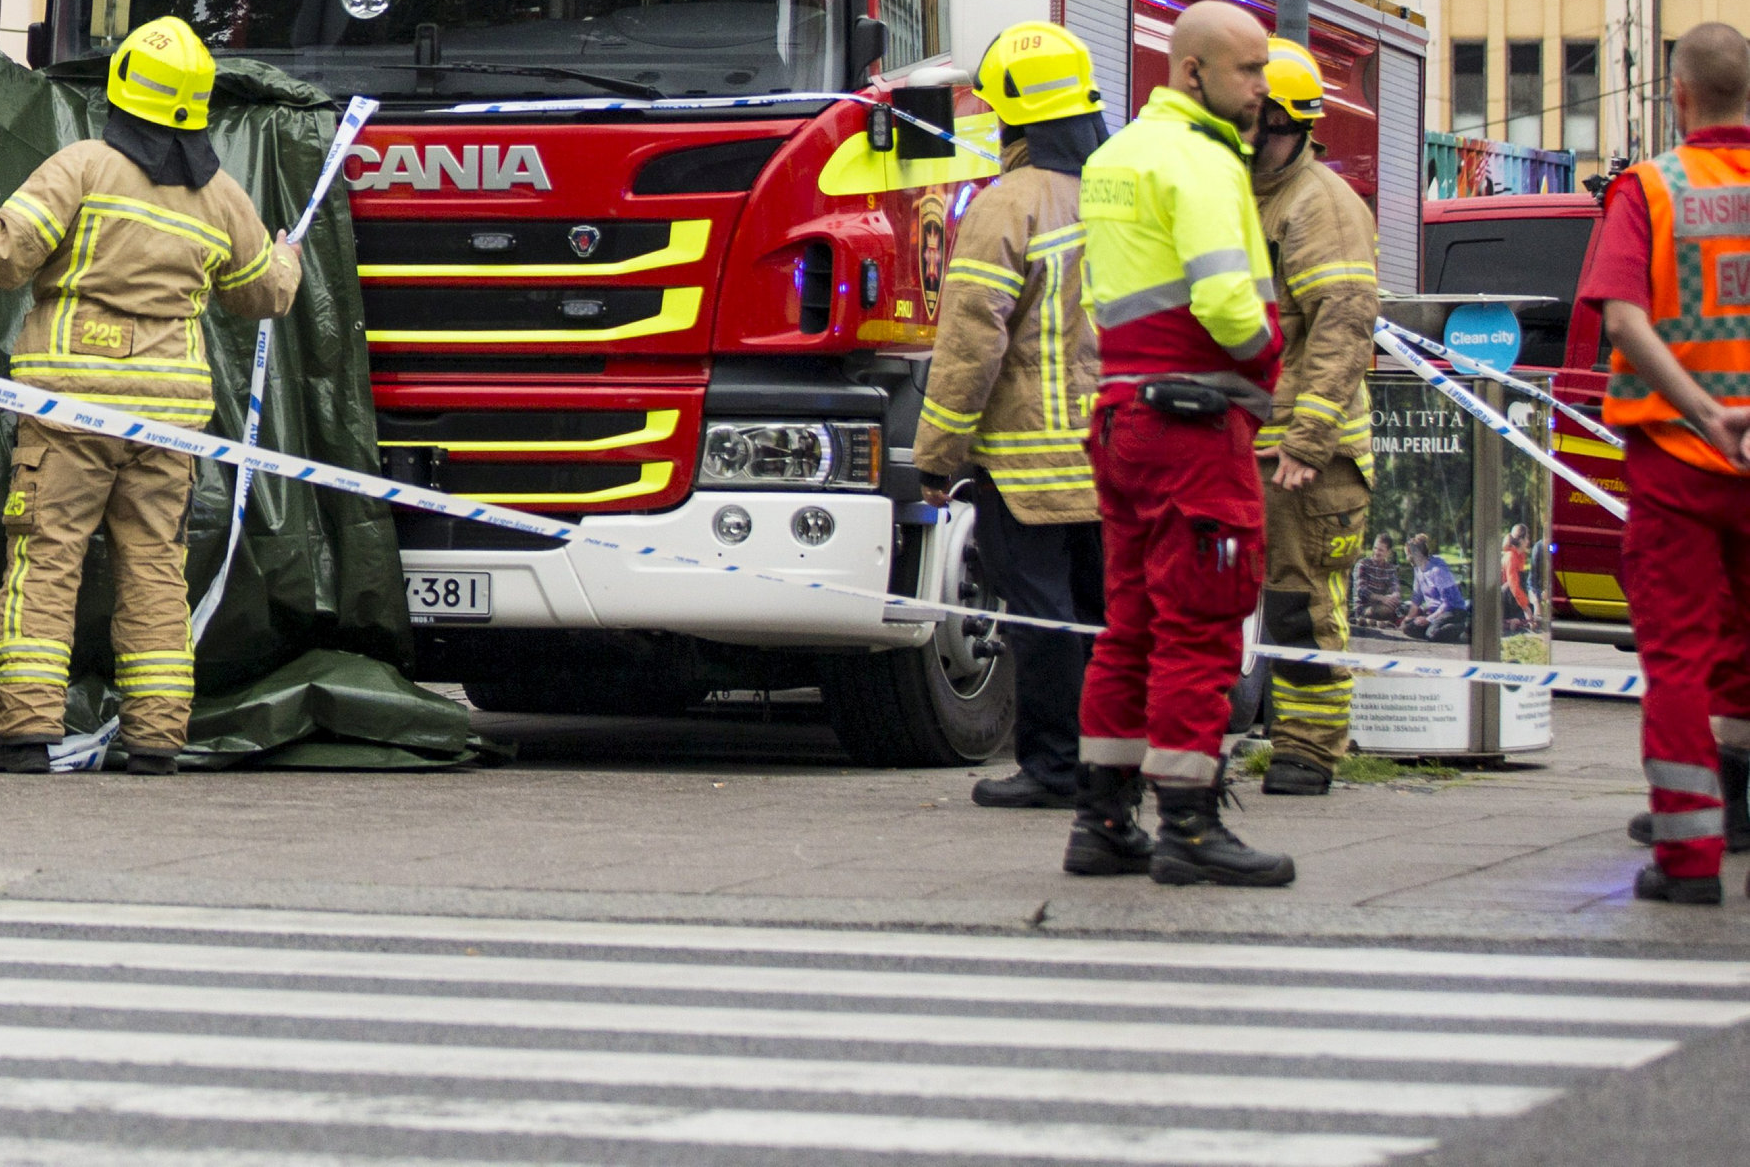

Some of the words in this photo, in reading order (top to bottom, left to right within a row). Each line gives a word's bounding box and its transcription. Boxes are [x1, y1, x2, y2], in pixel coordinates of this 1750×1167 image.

[142, 31, 172, 50] 225
[1012, 35, 1042, 54] 109
[343, 144, 552, 191] CANIA
[81, 320, 123, 349] 225
[1450, 331, 1489, 346] Clean
[1490, 329, 1516, 347] city
[256, 331, 267, 369] POLIS
[73, 412, 105, 429] POLIS
[1370, 409, 1465, 428] OAITTA
